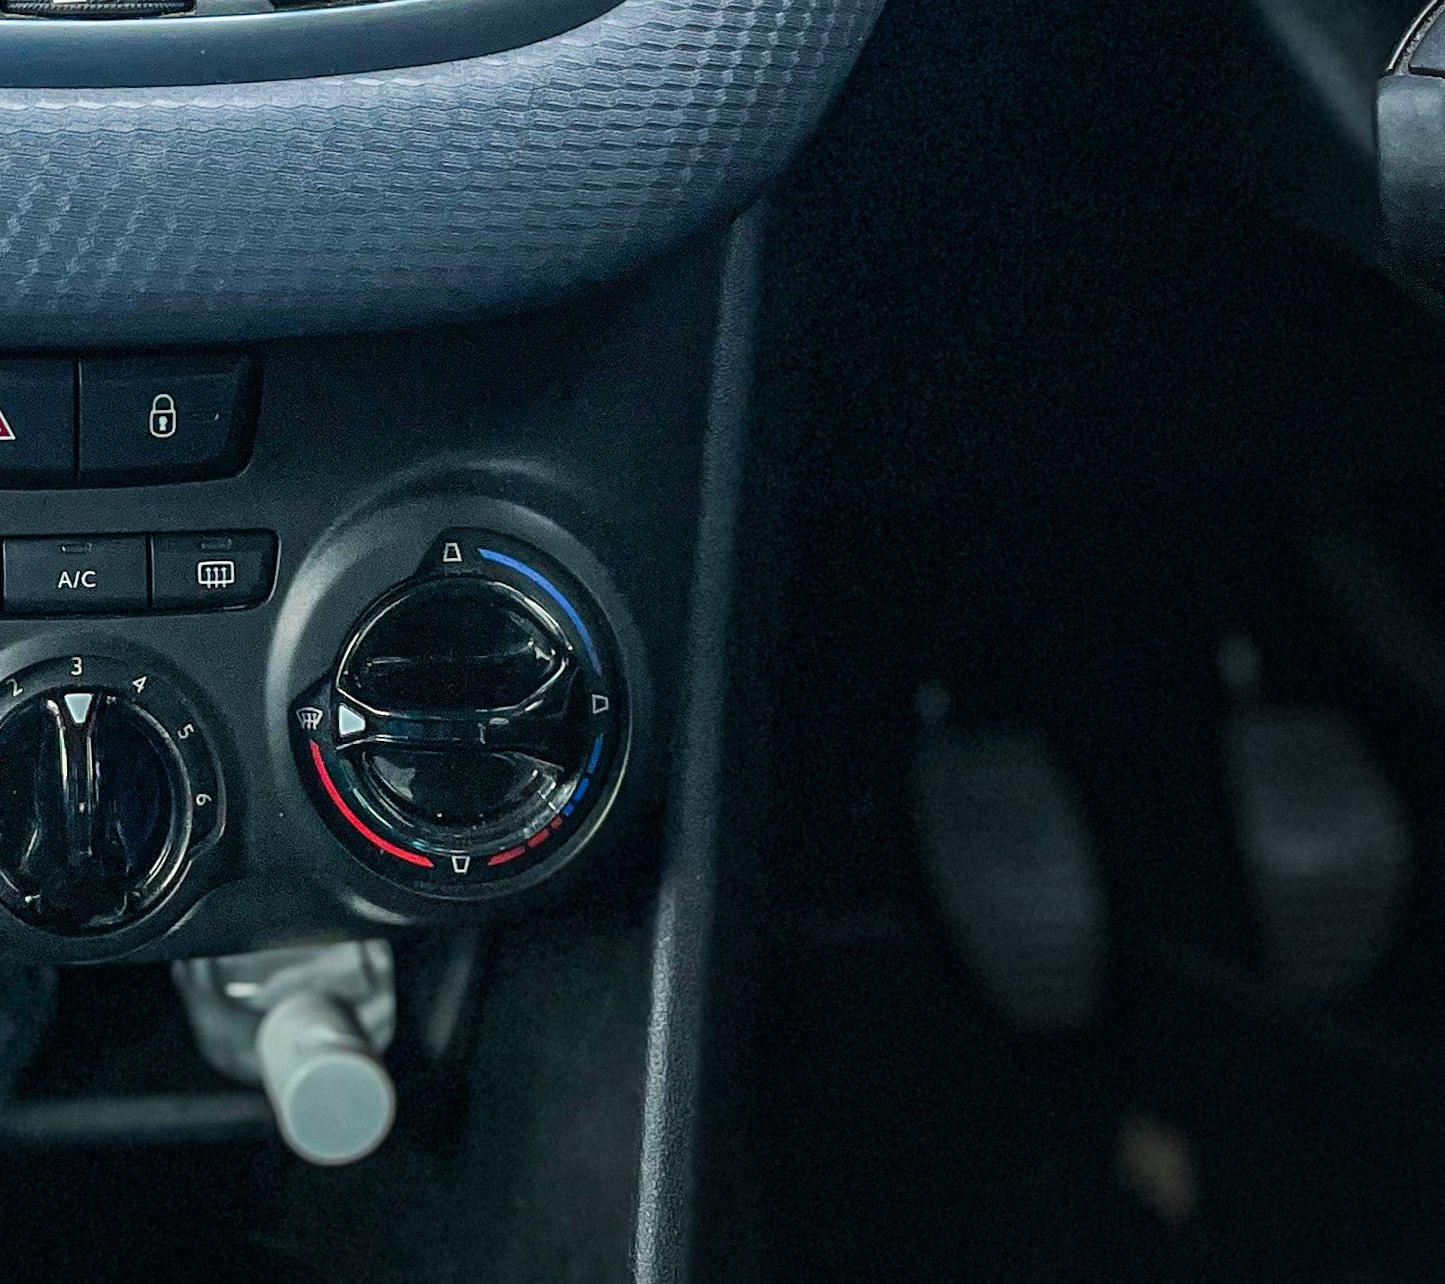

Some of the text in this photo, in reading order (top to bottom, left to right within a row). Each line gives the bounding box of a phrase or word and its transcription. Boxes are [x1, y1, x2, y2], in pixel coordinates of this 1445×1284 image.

[57, 570, 97, 589] A/C
[70, 656, 83, 676] 3
[6, 678, 23, 697] 2
[132, 675, 147, 693] 4
[177, 723, 194, 740] 5
[195, 792, 212, 807] 6
